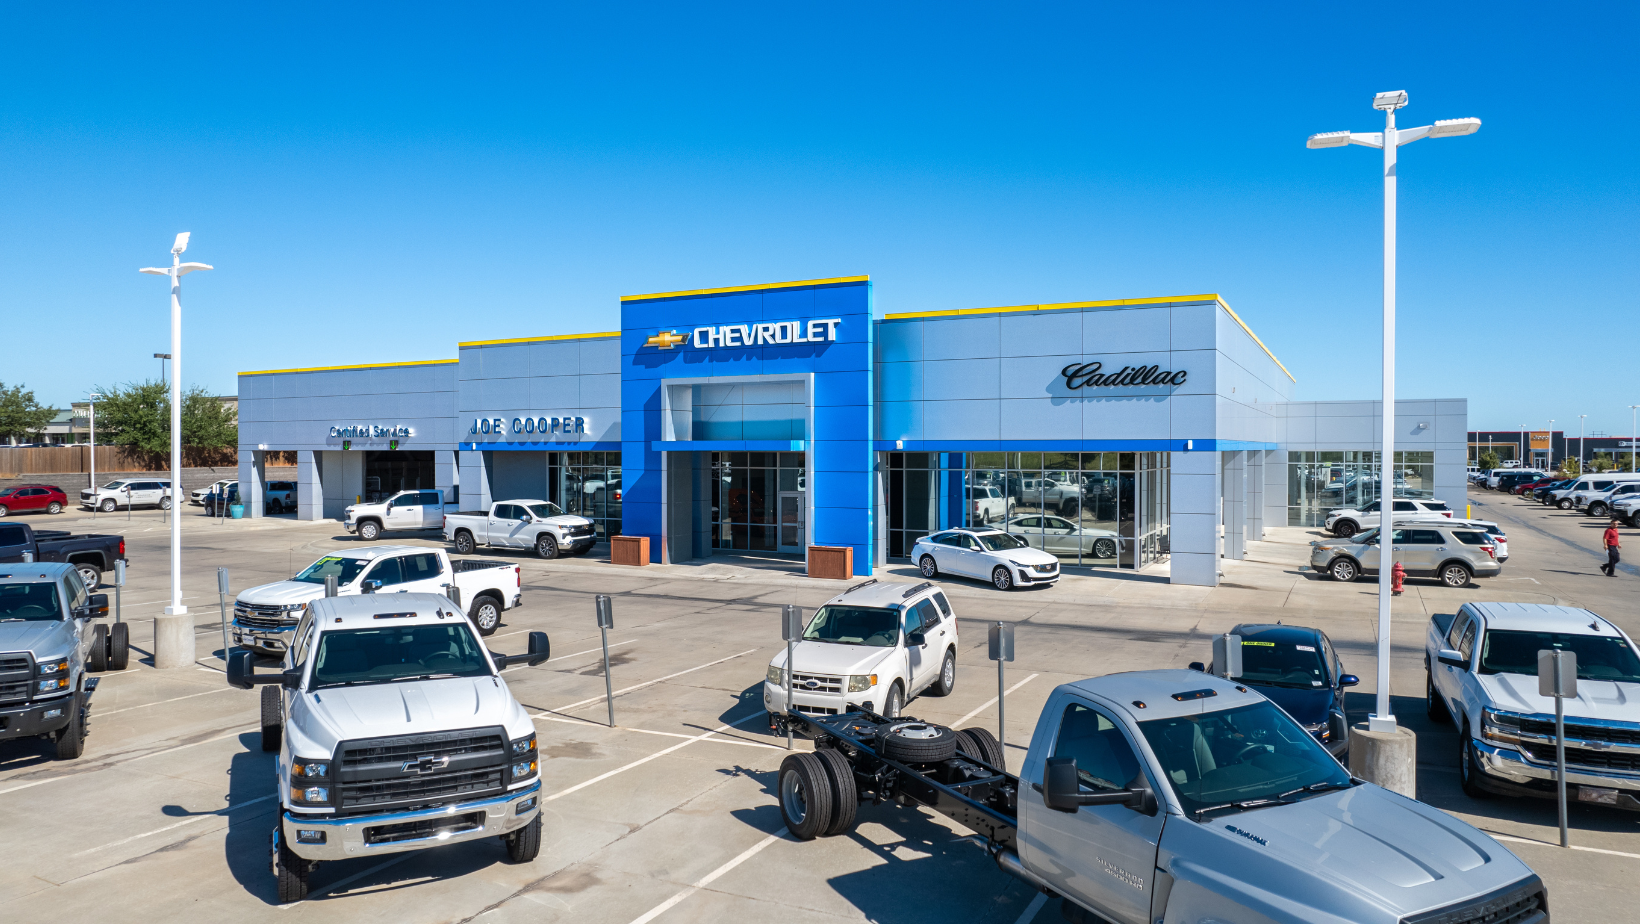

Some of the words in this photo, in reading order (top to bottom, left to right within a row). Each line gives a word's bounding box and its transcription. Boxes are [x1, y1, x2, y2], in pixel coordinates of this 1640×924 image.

[693, 318, 841, 349] CHEVROLET
[1061, 361, 1187, 390] Cadillac
[329, 425, 371, 438] Certified
[373, 425, 411, 438] Service
[470, 418, 503, 435] JOE
[512, 416, 587, 434] COOPER
[367, 730, 481, 747] CHEVROLET
